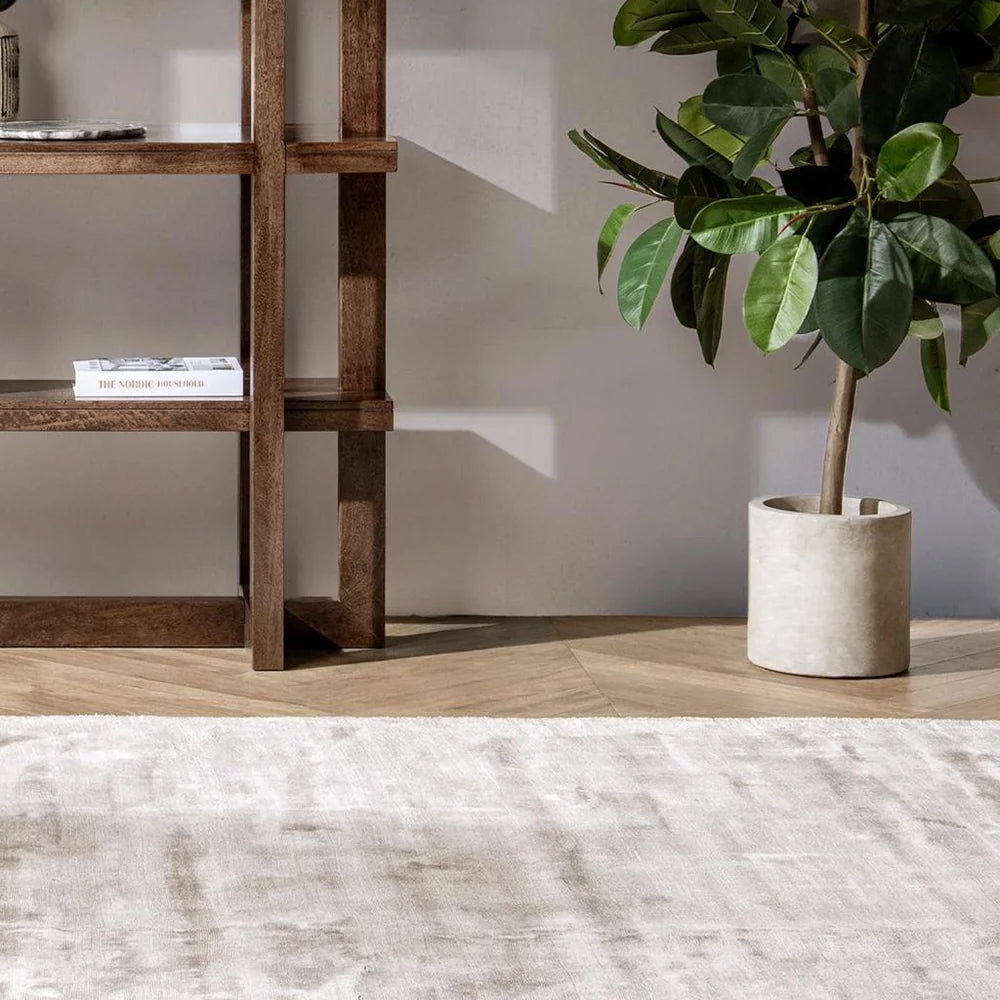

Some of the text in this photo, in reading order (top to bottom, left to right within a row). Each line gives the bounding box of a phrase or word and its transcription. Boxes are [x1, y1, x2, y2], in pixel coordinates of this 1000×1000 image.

[98, 380, 204, 389] THE NORDIC HOUSEHOLD
